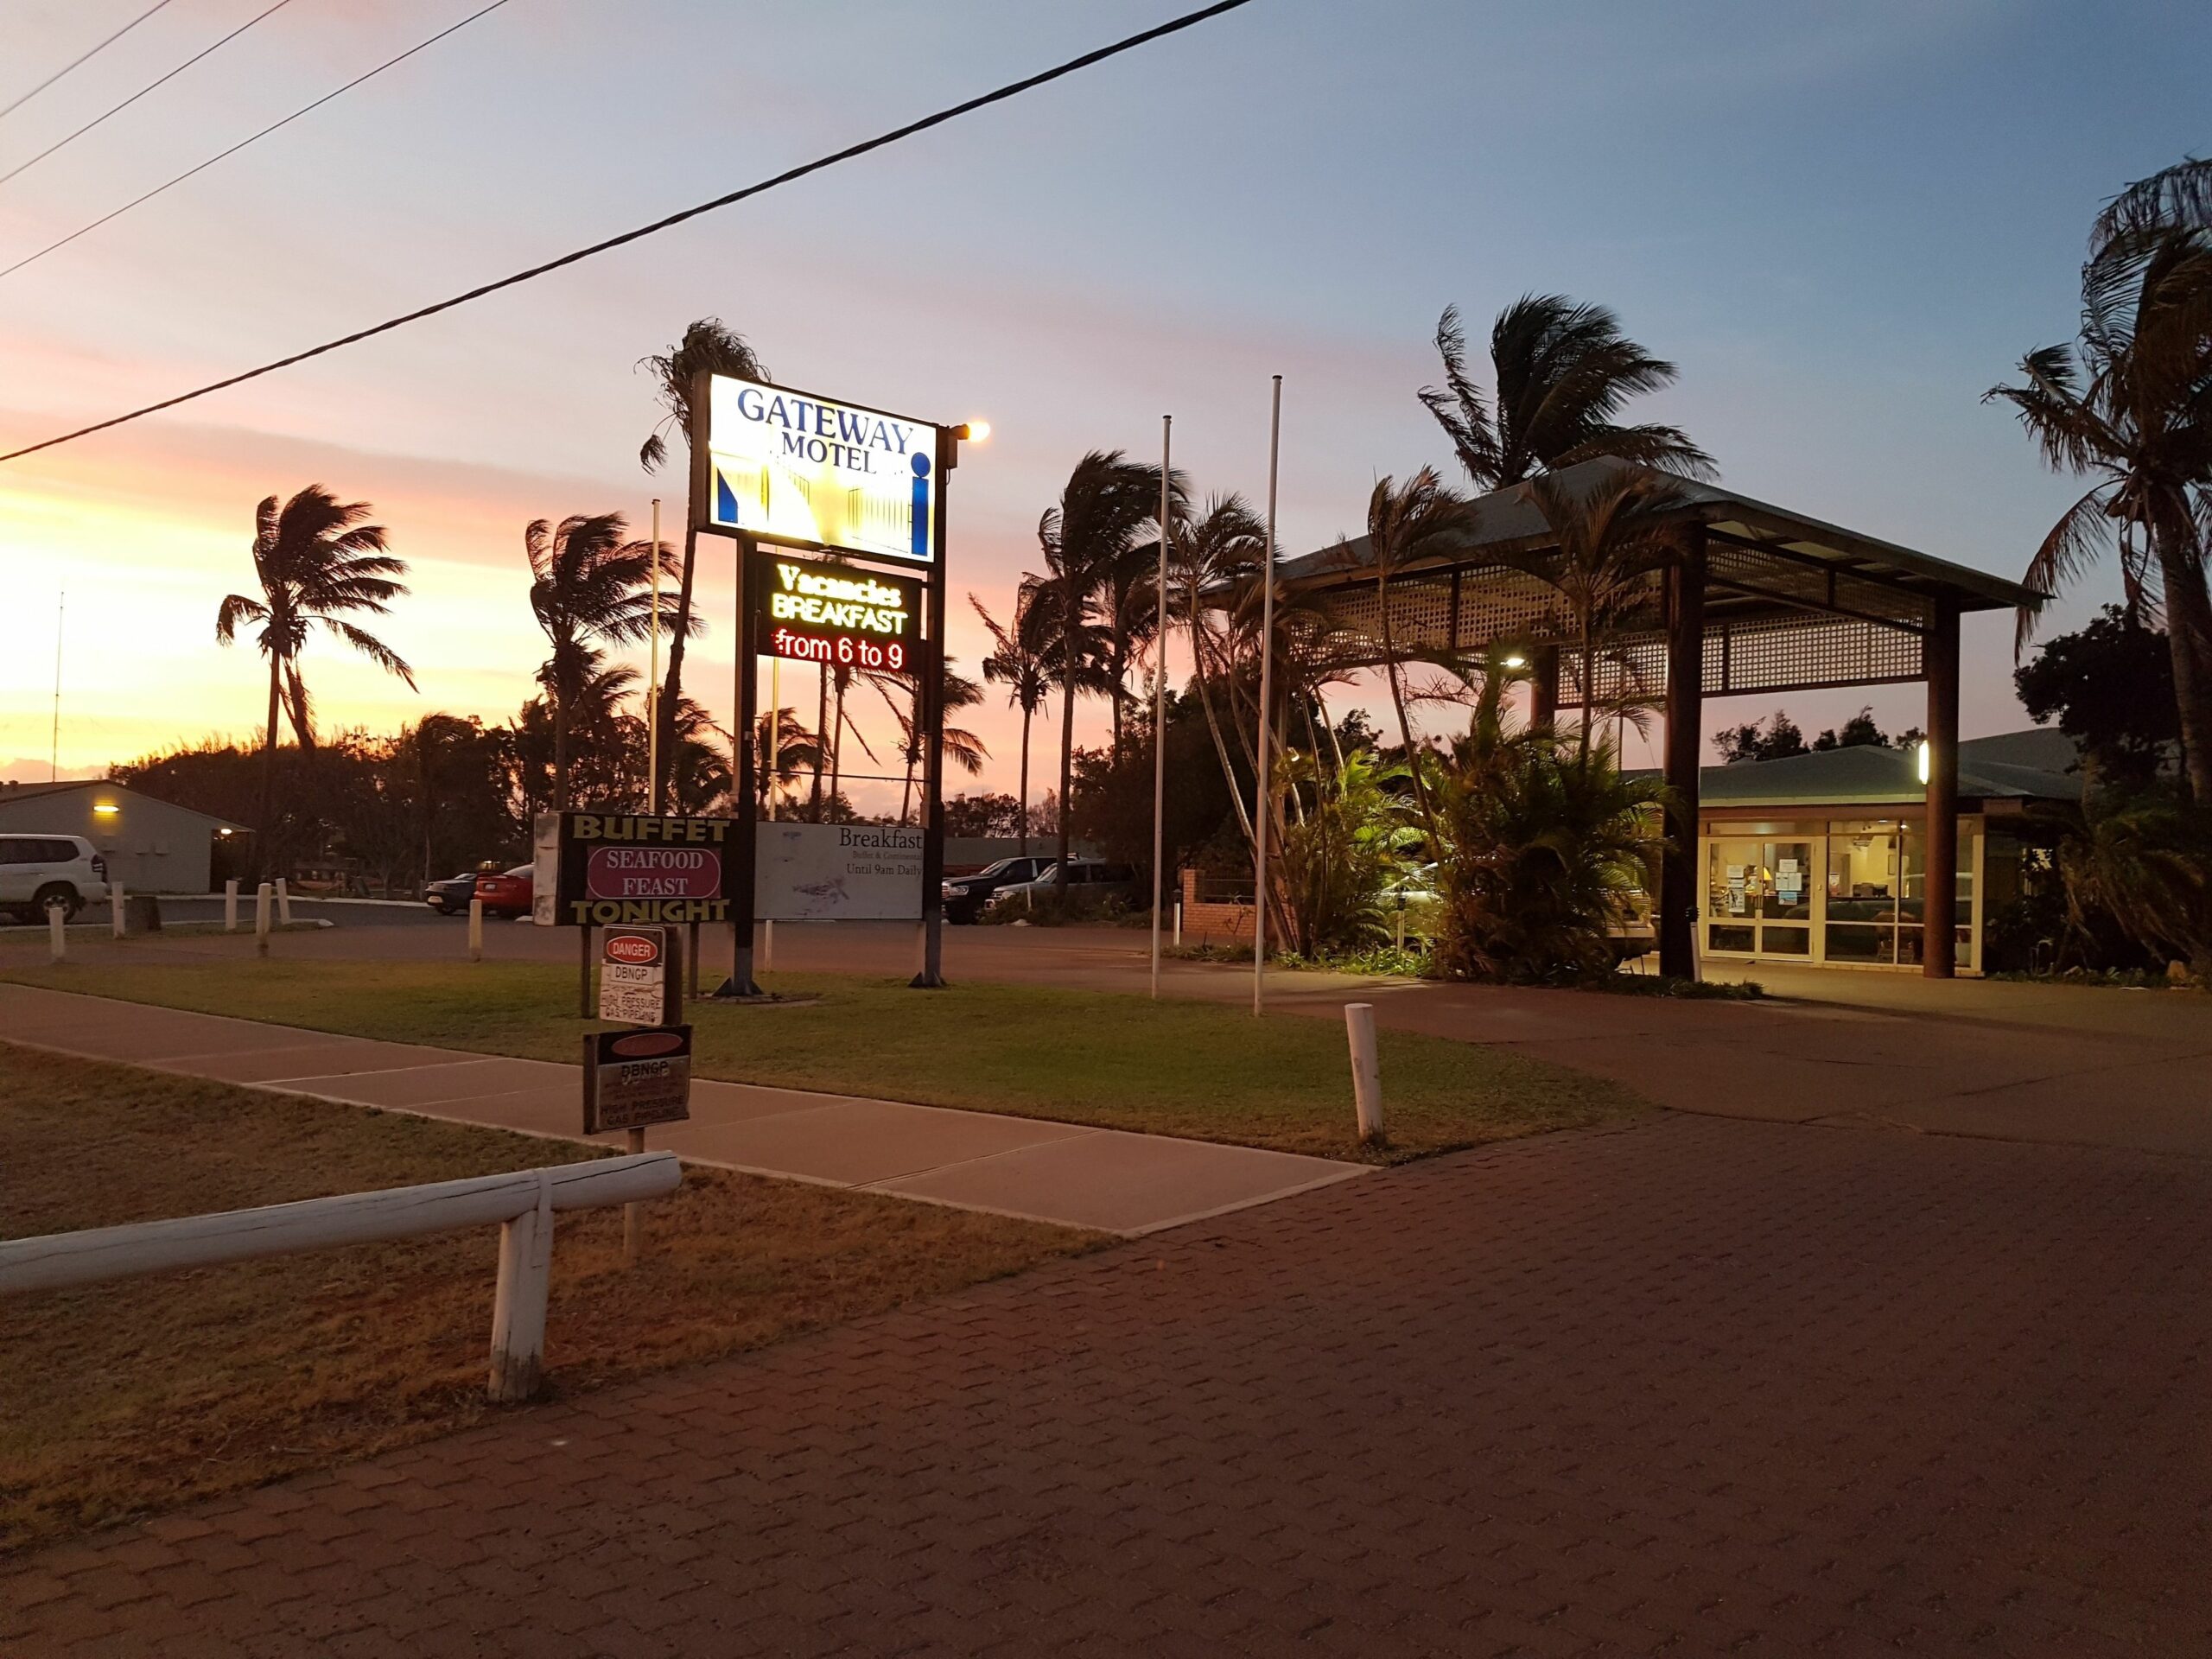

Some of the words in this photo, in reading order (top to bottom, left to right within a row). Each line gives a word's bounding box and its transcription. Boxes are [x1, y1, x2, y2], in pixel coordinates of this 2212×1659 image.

[737, 388, 914, 454] GATEWAY
[782, 431, 877, 474] MOTEL
[777, 563, 902, 607] Vacancies
[772, 594, 908, 634] BREAKFAST
[775, 629, 831, 660] from
[837, 638, 853, 663] 6
[858, 639, 882, 666] to
[888, 644, 903, 669] 9
[573, 815, 731, 842] BUFFET
[839, 827, 923, 849] Breakfast
[607, 850, 703, 869] SEAFOOD
[847, 863, 871, 874] Until
[874, 864, 894, 875] 9am
[898, 865, 922, 877] Daily
[622, 877, 688, 895] FEAST
[570, 899, 731, 924] TONIGHT
[613, 942, 651, 957] DANGER
[615, 966, 647, 980] DBNGP
[621, 1061, 669, 1077] DBNGP
[607, 1114, 629, 1125] GAS
